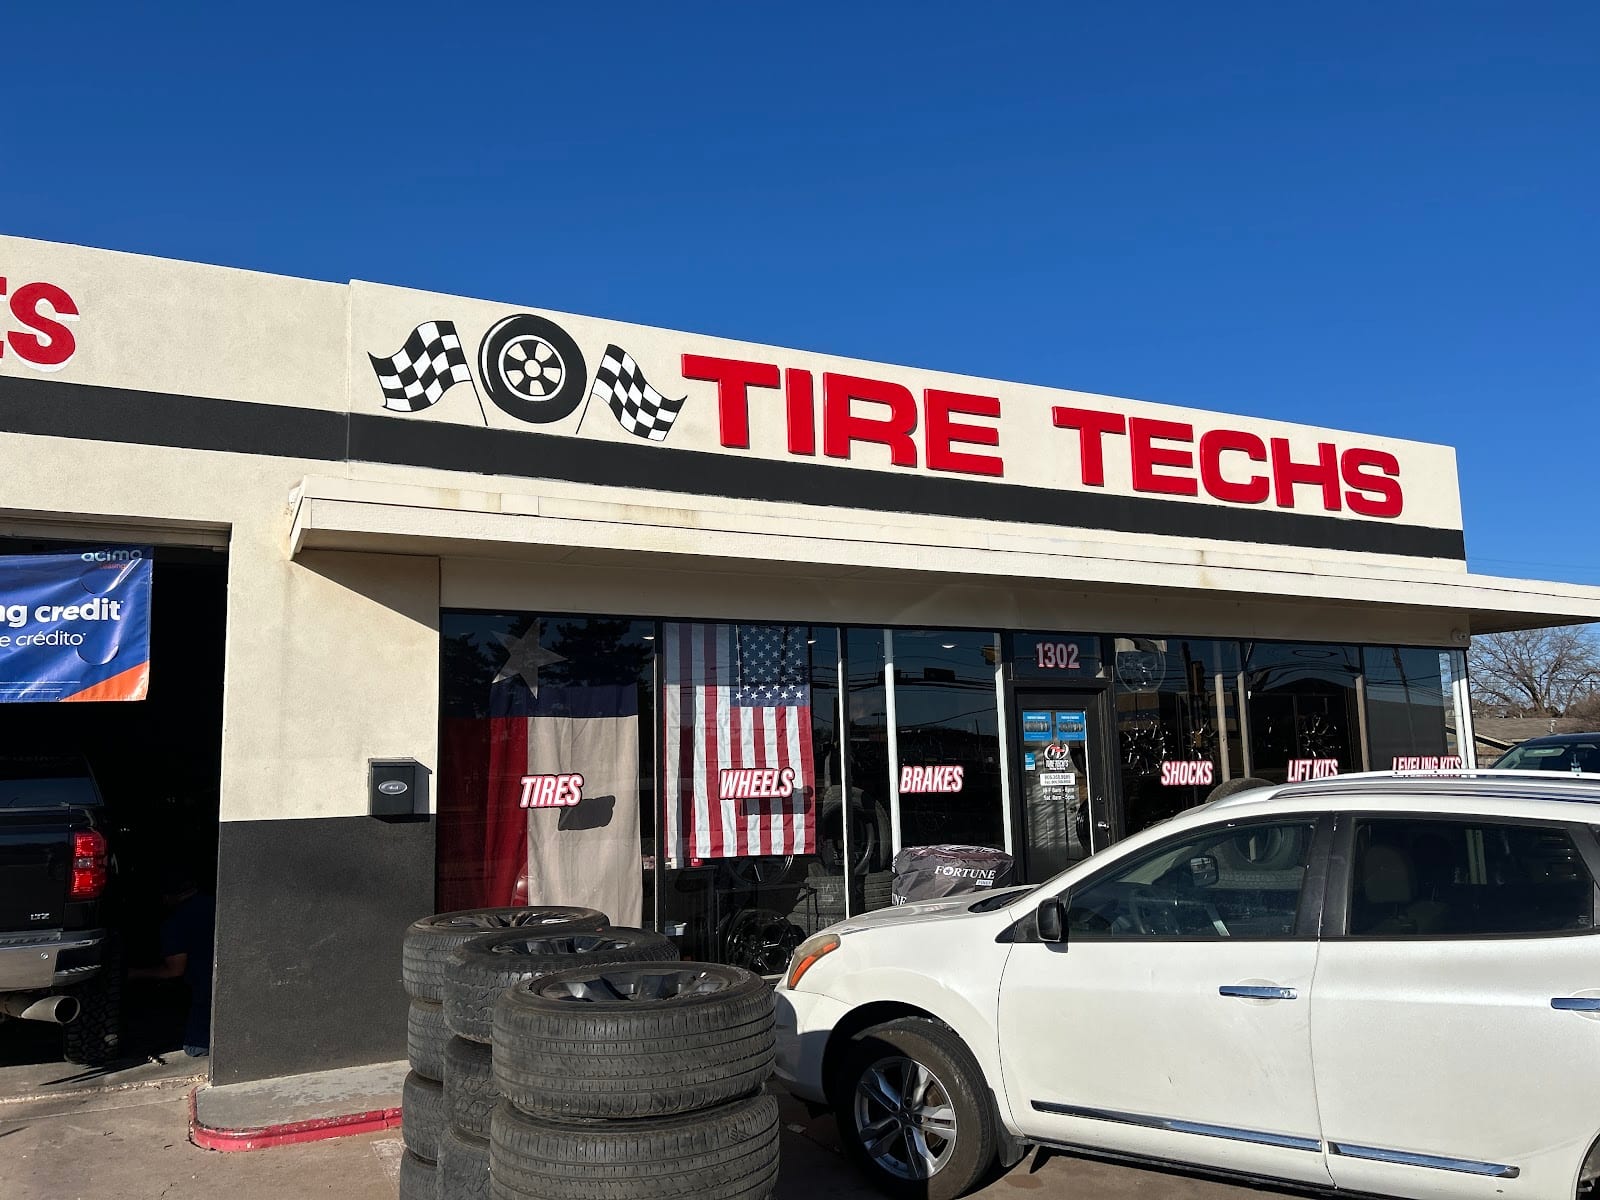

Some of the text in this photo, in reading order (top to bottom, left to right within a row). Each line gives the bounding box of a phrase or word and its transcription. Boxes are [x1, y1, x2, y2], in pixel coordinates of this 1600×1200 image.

[681, 353, 1403, 518] TIRE TECHS
[80, 549, 142, 562] acima
[1036, 642, 1080, 669] 1302
[1160, 760, 1213, 786] SHOCKS
[1287, 758, 1339, 782] LIFT KITS
[1439, 756, 1462, 775] KITS
[519, 773, 584, 808] TIRES
[719, 767, 795, 800] WHEELS
[900, 765, 964, 793] BRAKES
[934, 865, 997, 879] FORTUNE
